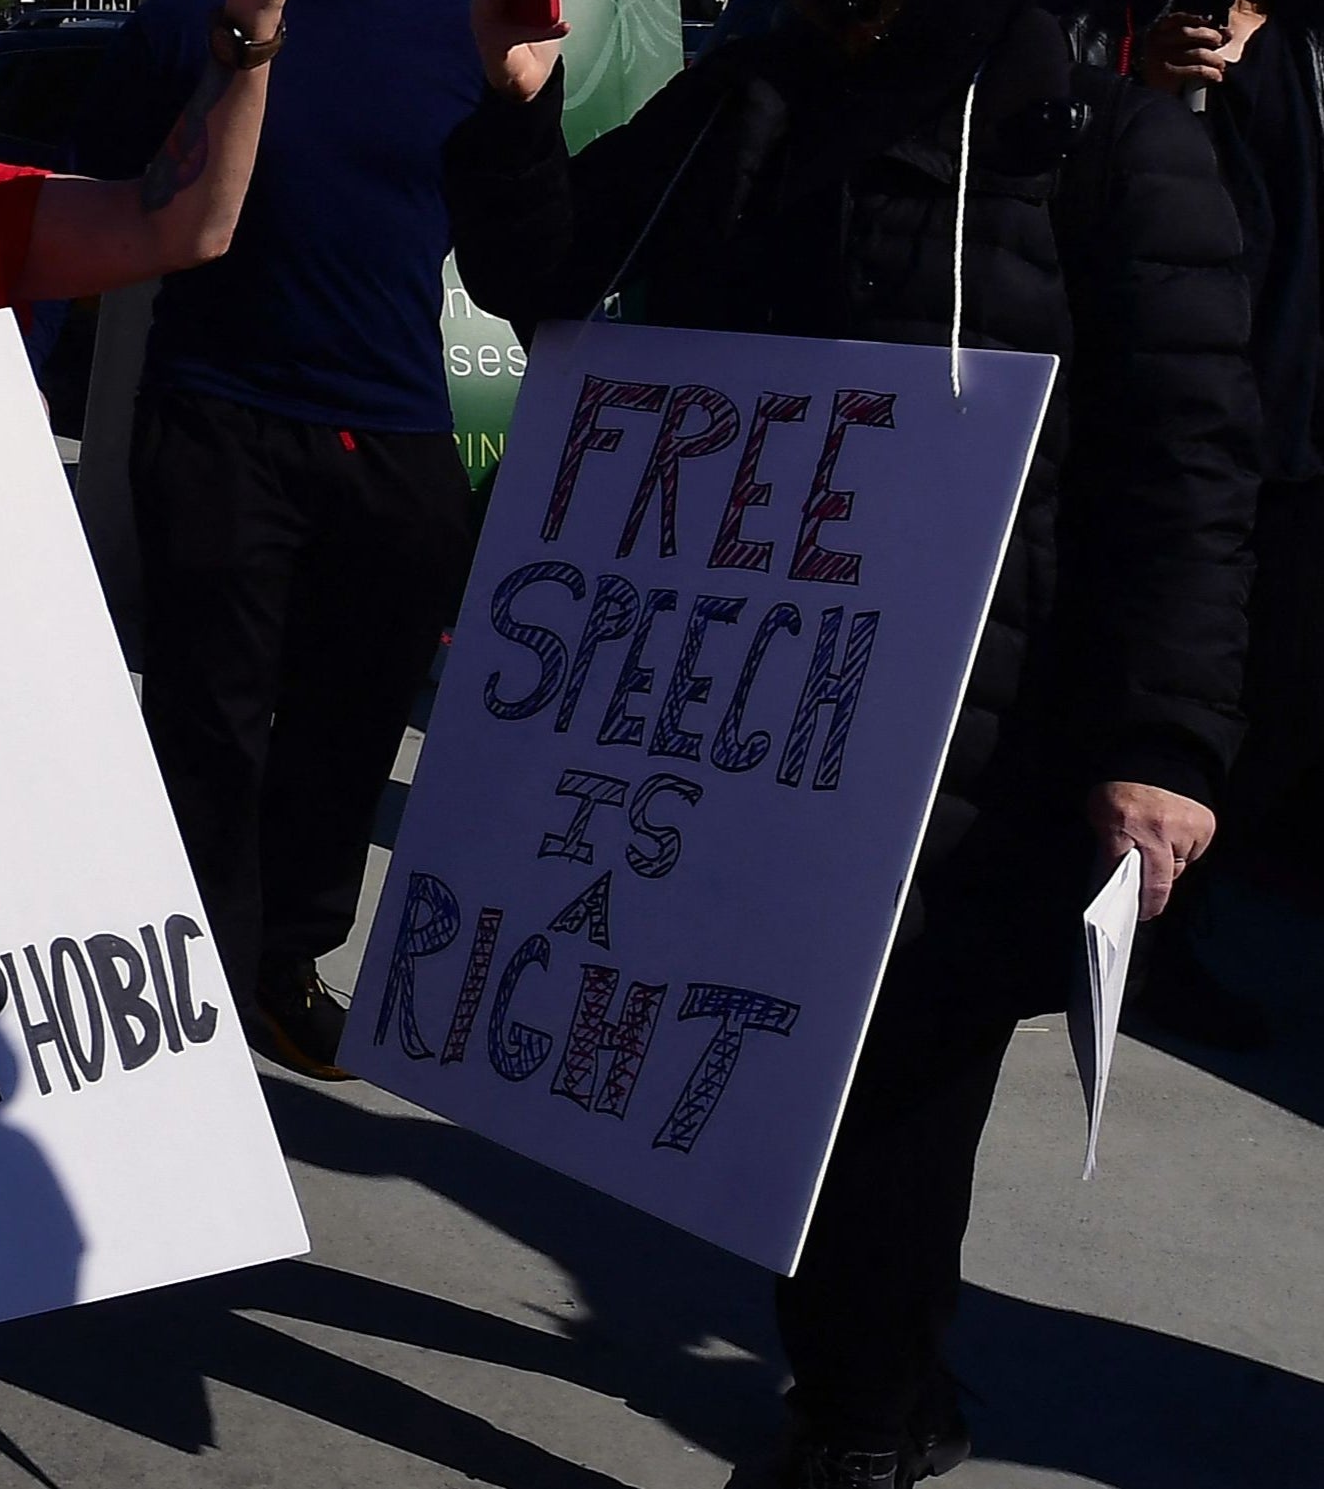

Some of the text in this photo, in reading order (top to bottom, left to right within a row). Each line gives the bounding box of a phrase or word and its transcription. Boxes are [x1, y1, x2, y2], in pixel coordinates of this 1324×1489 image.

[544, 373, 898, 585] FREE
[482, 560, 881, 791] SPEECH
[536, 767, 706, 881] IS
[548, 869, 614, 950] A
[372, 870, 802, 1155] RIGHT
